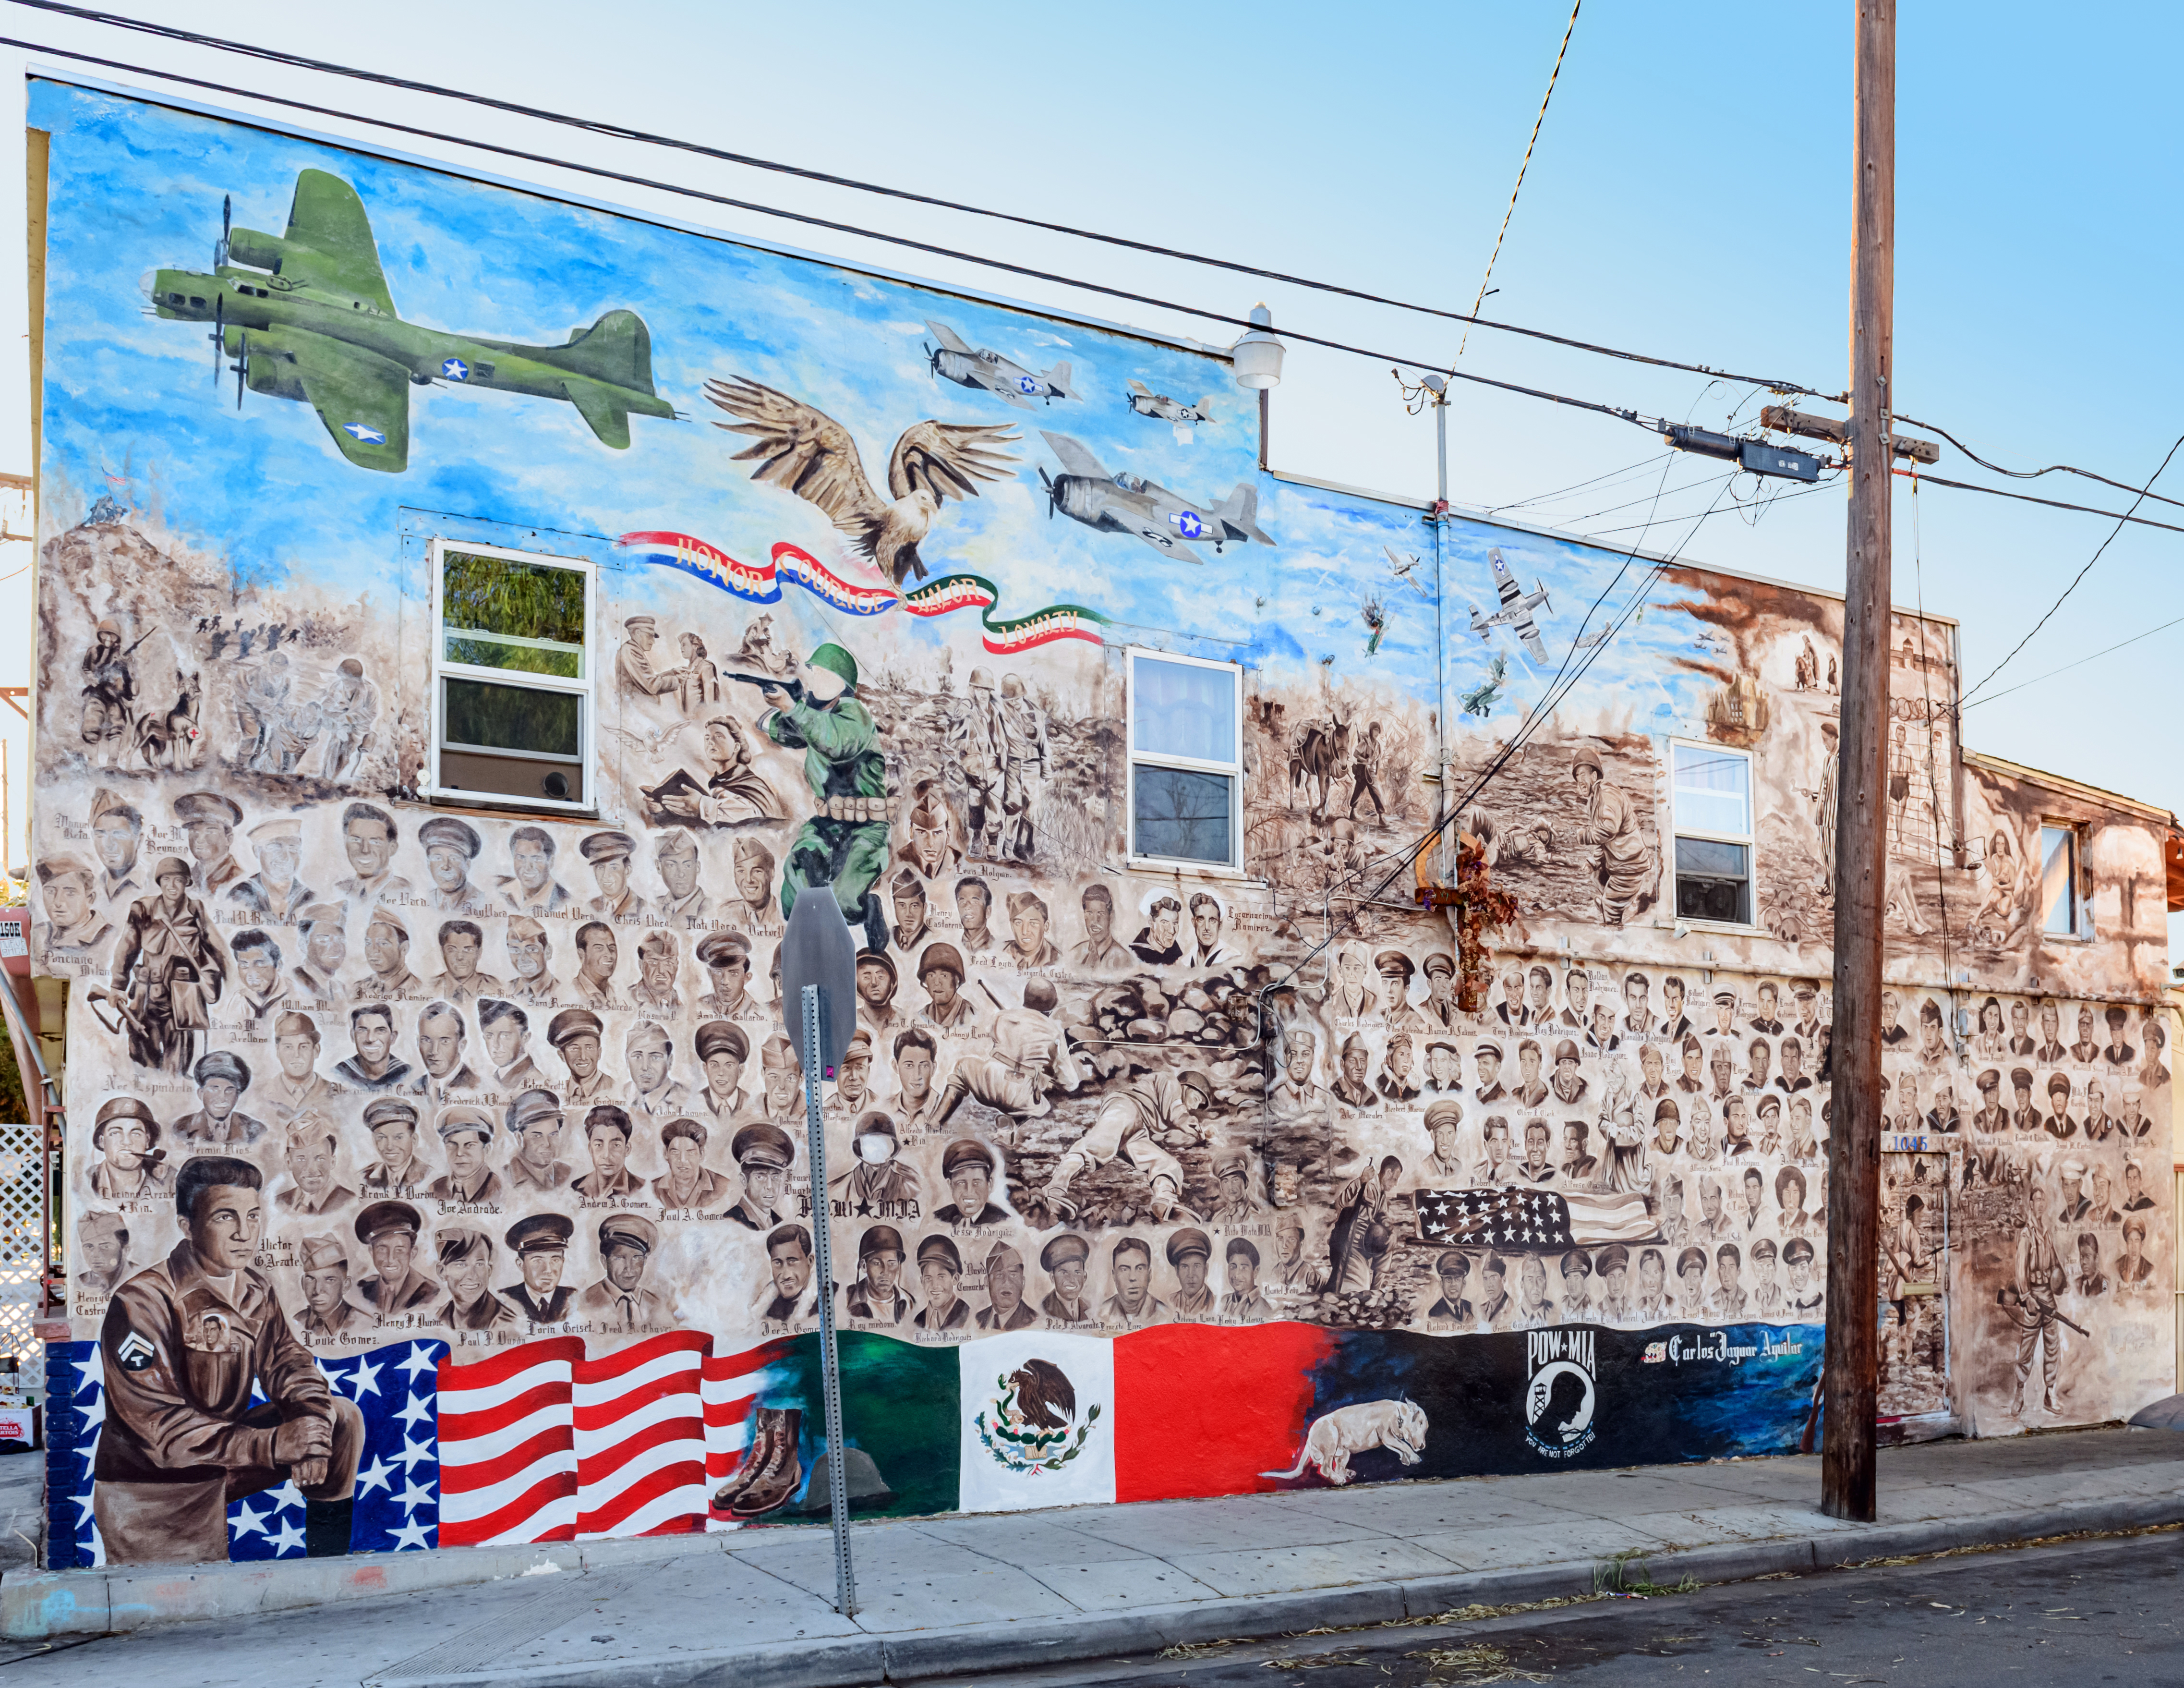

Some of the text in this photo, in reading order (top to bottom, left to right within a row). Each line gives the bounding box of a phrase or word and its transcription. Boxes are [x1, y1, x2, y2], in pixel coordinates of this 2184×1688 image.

[676, 538, 1077, 649] HONOR COURAGE VALOR LOYALTY
[954, 863, 977, 876] Louis
[927, 903, 953, 918] Henry
[615, 914, 640, 926] Chris
[355, 987, 393, 1001] Rodrigo
[942, 1027, 969, 1039] Johnny
[1893, 1136, 1927, 1151] 1045
[437, 1200, 457, 1215] Joe
[260, 1236, 292, 1252] Victor
[965, 1261, 987, 1277] David
[73, 1291, 104, 1305] Henry
[373, 1312, 405, 1331] Henry
[301, 1331, 335, 1348] Louie
[1669, 1334, 1711, 1366] Carlos
[1759, 1331, 1802, 1363] Aguilar
[1527, 1331, 1596, 1382] POW MIA
[1525, 1433, 1595, 1458] YOU ARE NOT FORGOTTEN
